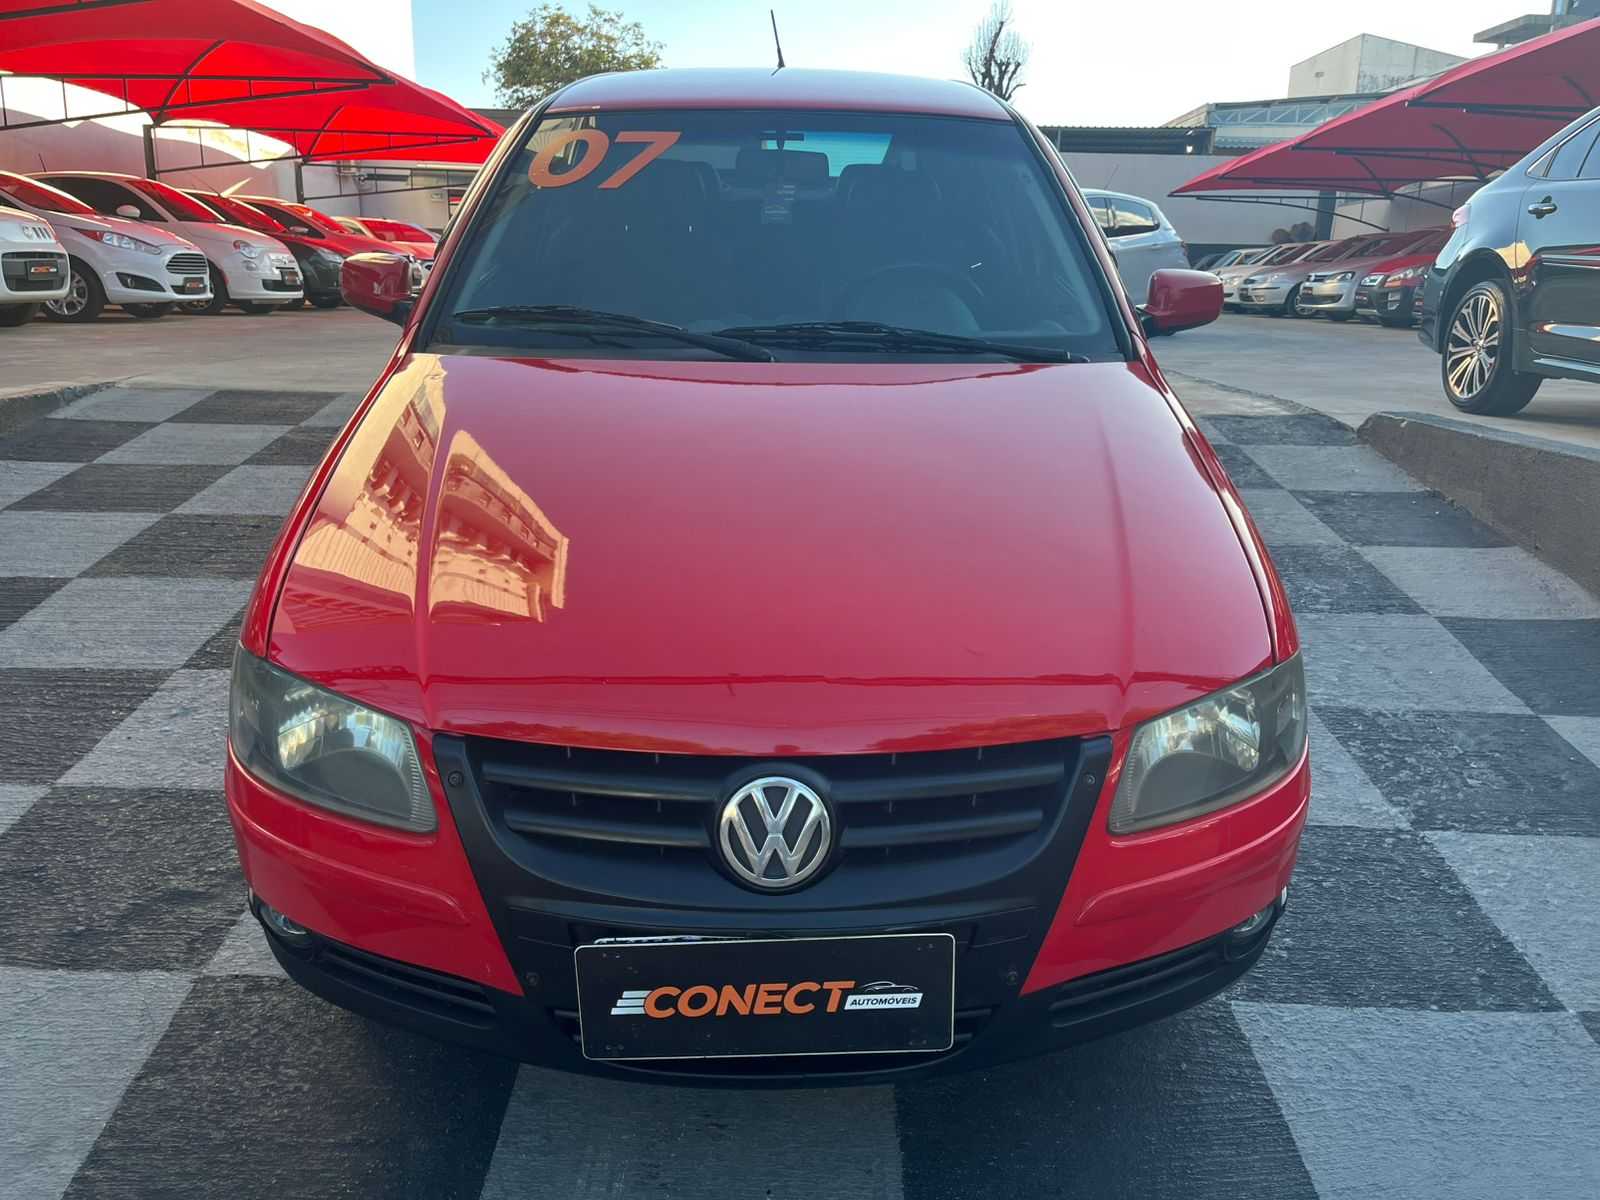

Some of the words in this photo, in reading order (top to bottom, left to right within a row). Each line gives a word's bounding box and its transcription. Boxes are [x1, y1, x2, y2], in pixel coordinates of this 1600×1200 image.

[527, 129, 682, 189] 07
[725, 781, 827, 884] VW
[643, 980, 856, 1018] CONECT
[850, 996, 918, 1007] AUTOMÓVEIS
